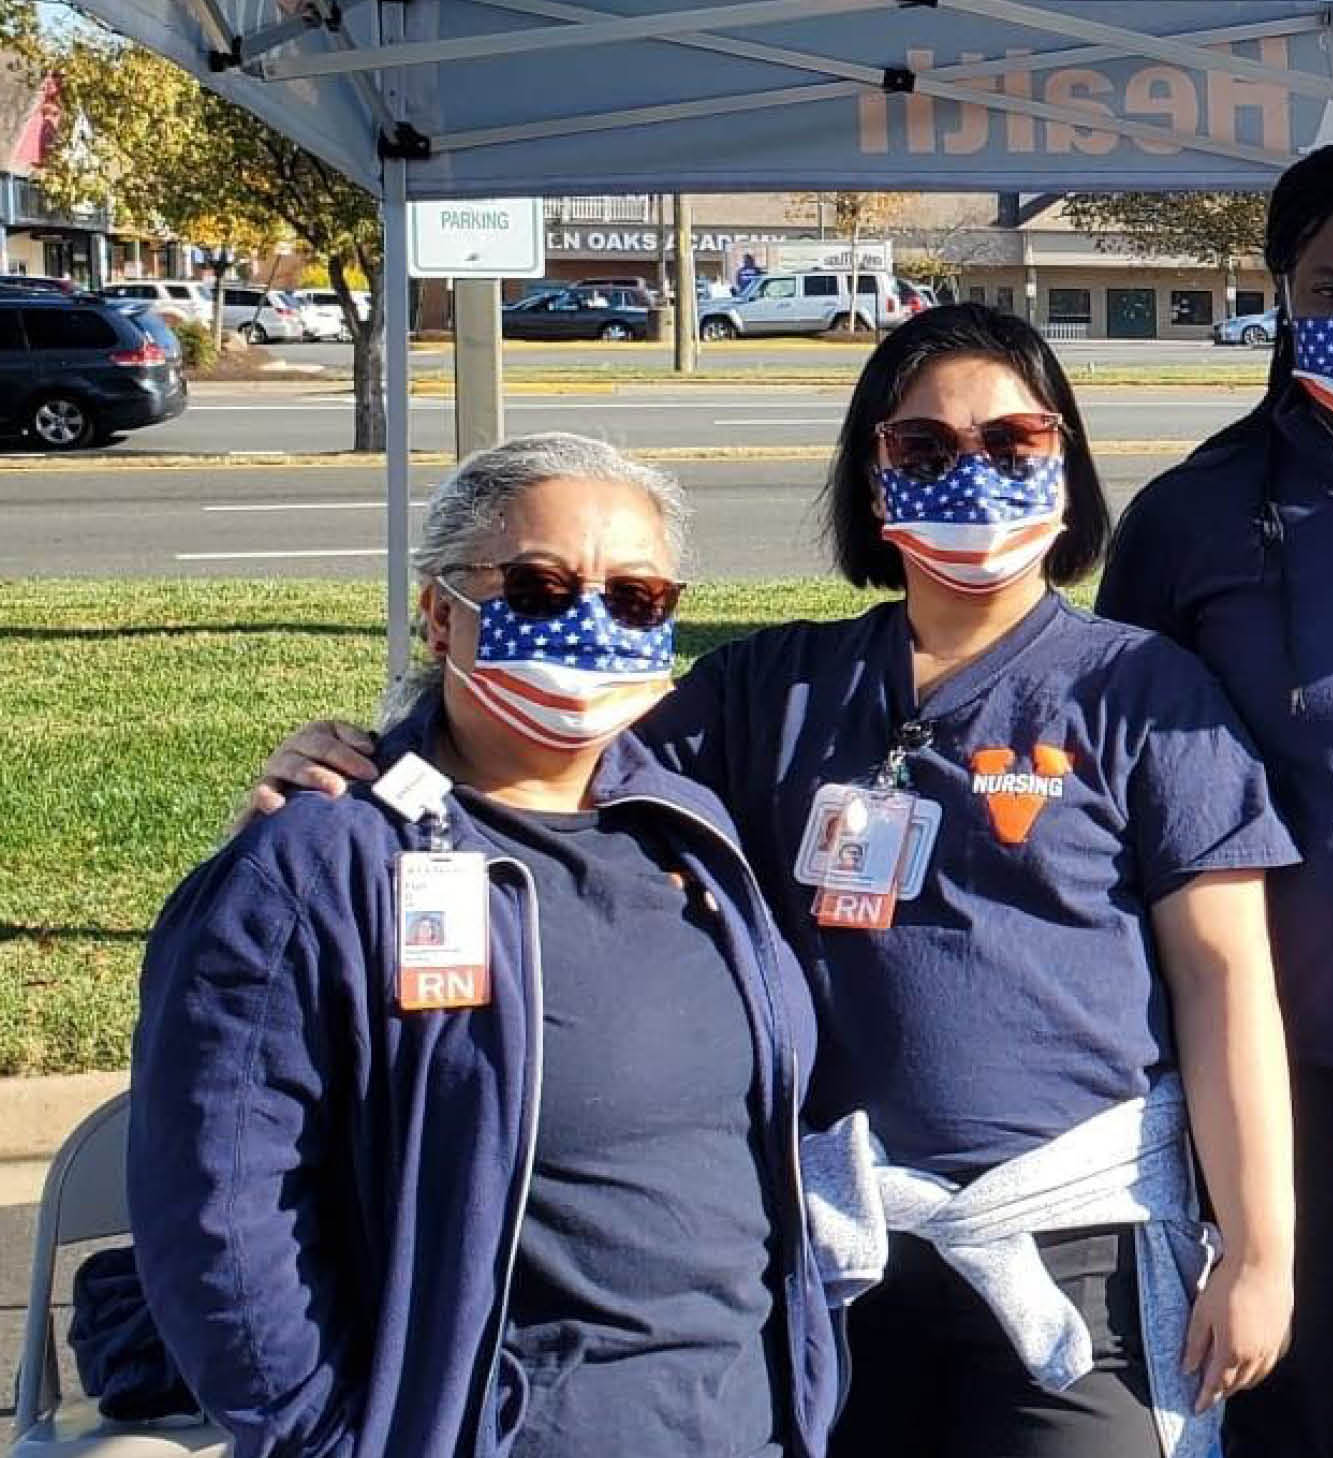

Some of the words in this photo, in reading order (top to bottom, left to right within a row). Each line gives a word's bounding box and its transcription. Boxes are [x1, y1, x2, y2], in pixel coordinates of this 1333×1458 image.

[440, 210, 510, 231] PARKING
[588, 232, 657, 249] OAKS
[972, 773, 1063, 797] NURSING
[836, 895, 883, 921] RN
[417, 969, 475, 1001] RN
